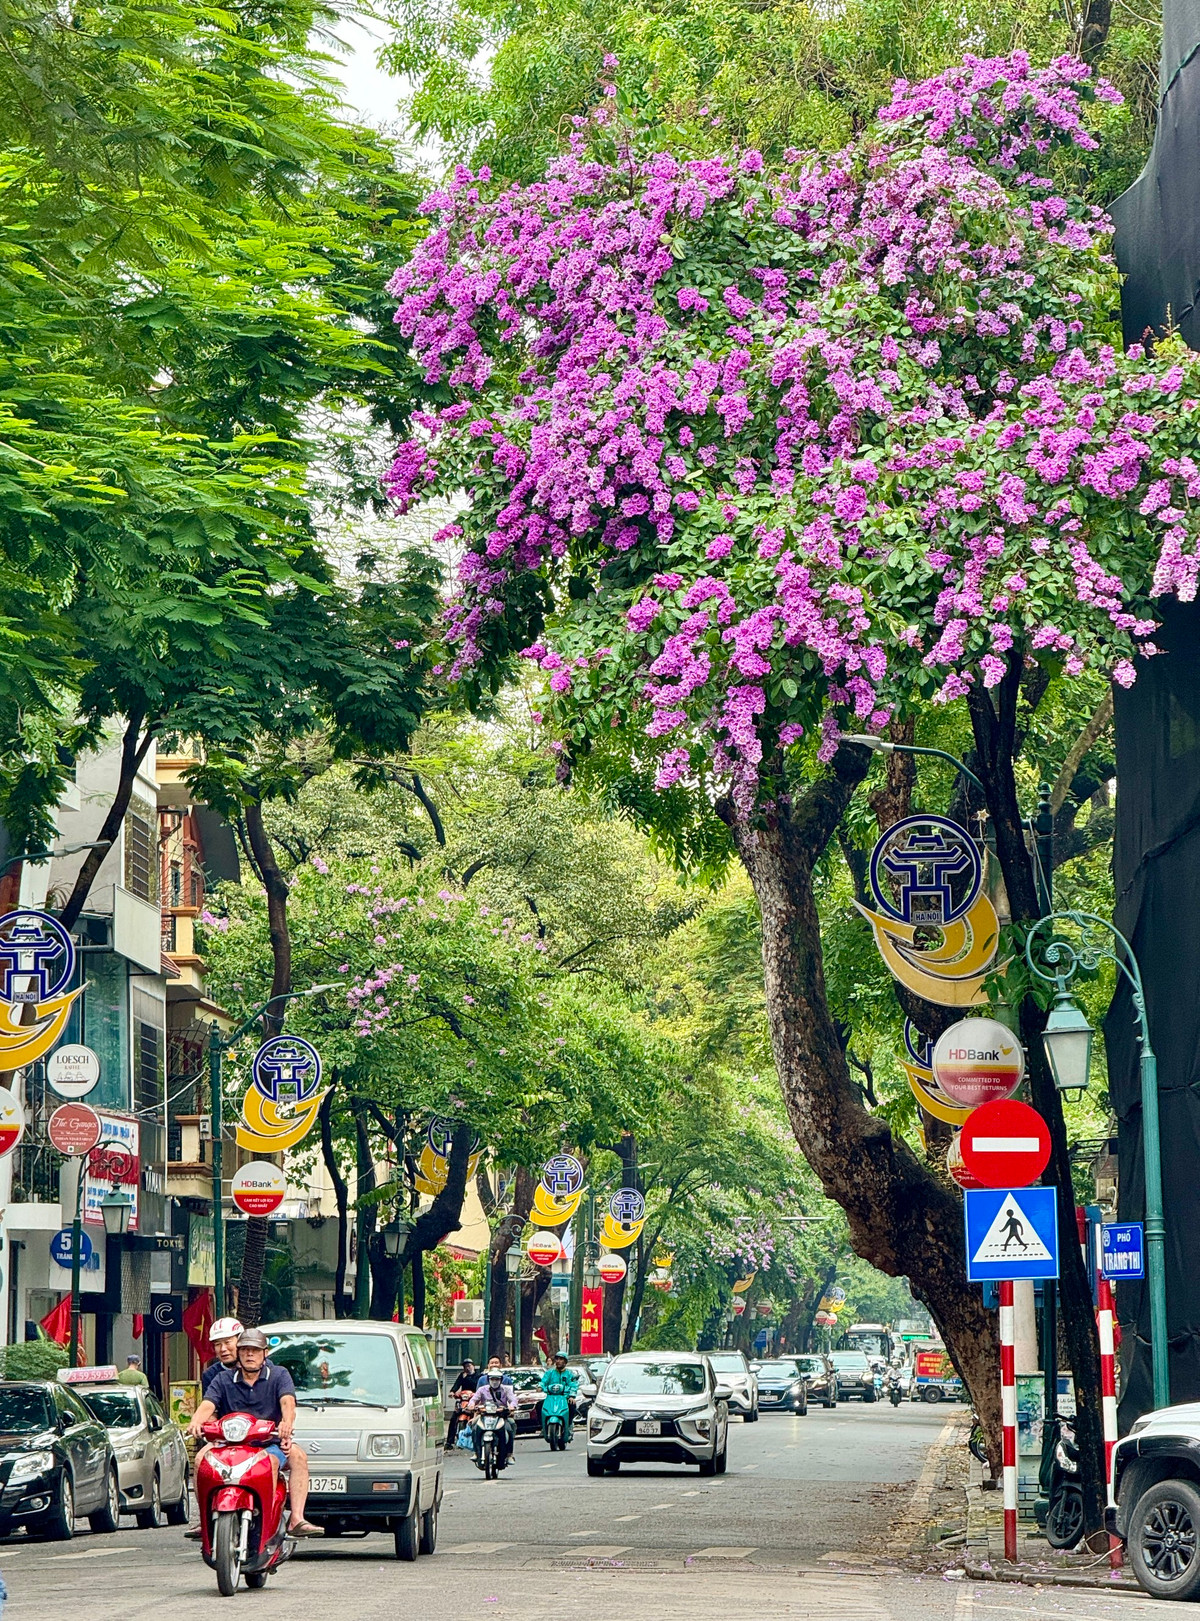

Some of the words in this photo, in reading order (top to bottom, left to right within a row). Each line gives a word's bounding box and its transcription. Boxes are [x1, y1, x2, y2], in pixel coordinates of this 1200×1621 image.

[56, 1055, 89, 1064] LOESCH
[949, 1048, 1000, 1061] HDBank
[52, 1116, 68, 1128] The
[69, 1117, 98, 1130] Ganges
[241, 1180, 272, 1188] HDBank
[1116, 1229, 1132, 1243] PHỐ
[1104, 1248, 1128, 1271] TRÀNG
[1128, 1251, 1141, 1270] THI
[582, 1318, 599, 1333] 30-4
